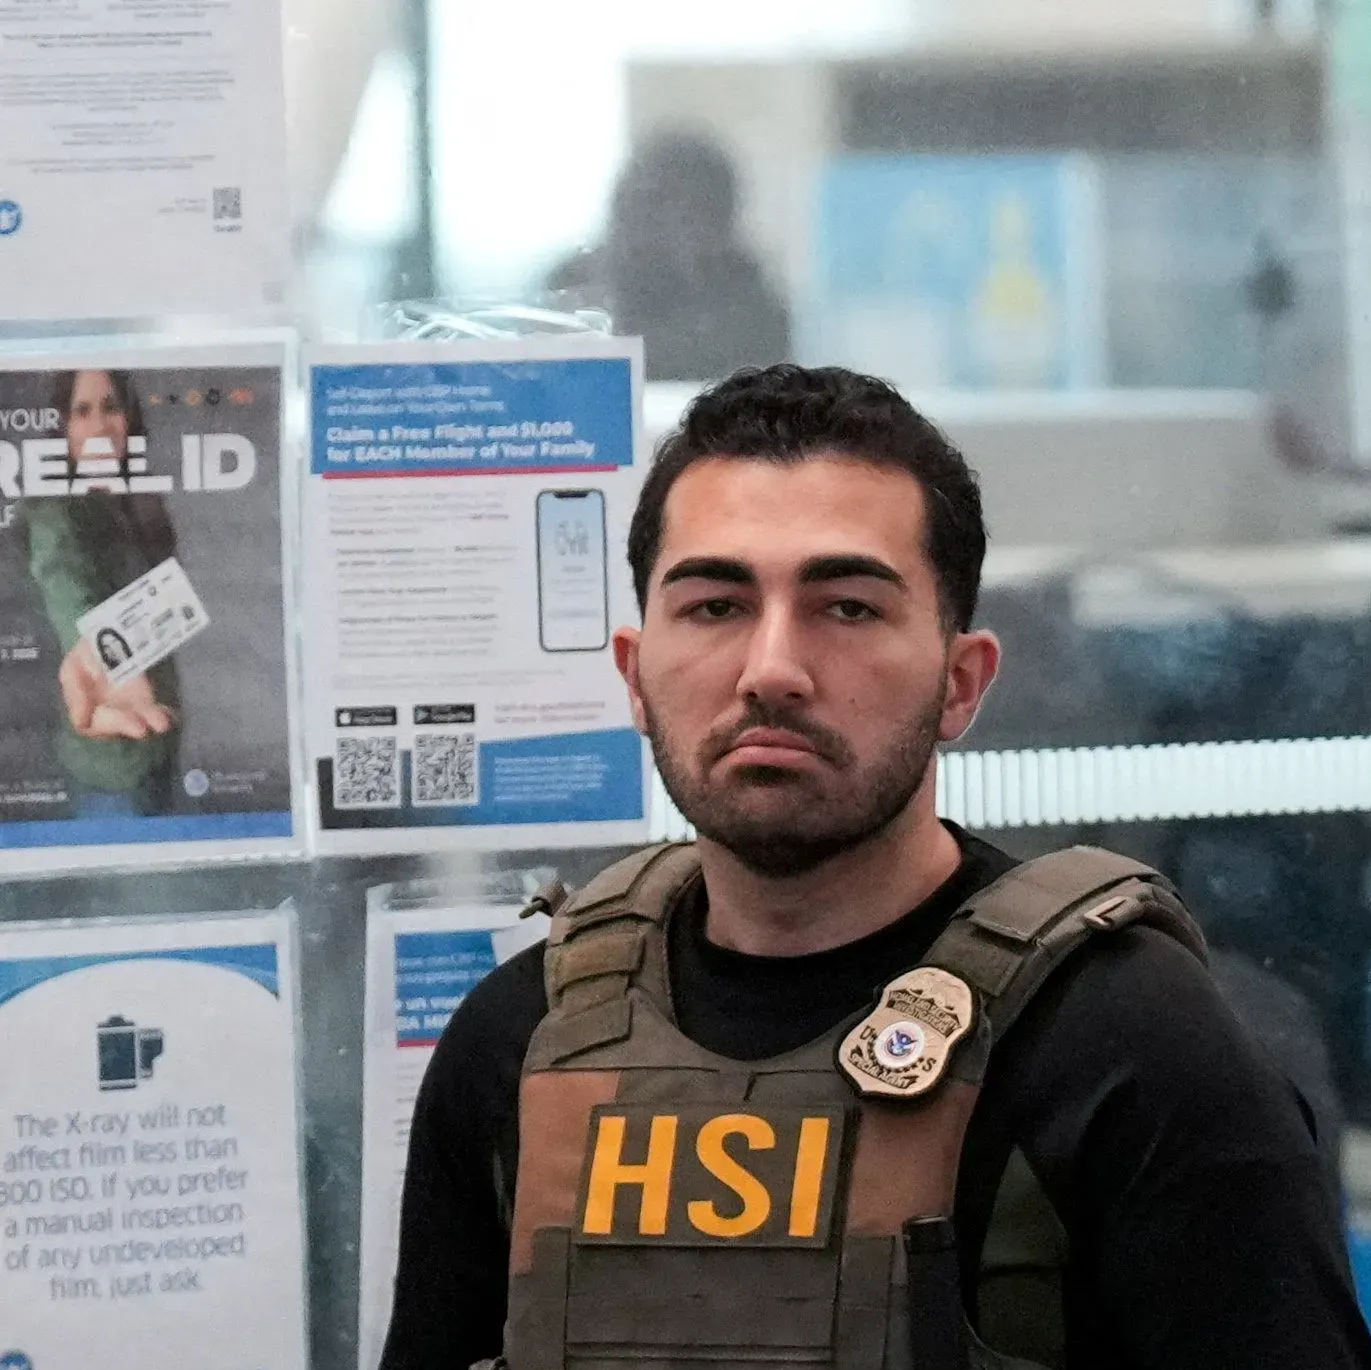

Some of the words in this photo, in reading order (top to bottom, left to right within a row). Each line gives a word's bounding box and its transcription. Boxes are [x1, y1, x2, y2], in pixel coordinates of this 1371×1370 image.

[0, 407, 60, 432] YOUR
[181, 433, 256, 492] ID
[14, 1113, 58, 1138] The
[64, 1110, 130, 1136] X-ray
[137, 1104, 179, 1131] will
[186, 1103, 226, 1127] not
[4, 1144, 71, 1173] affect
[78, 1142, 126, 1168] film
[133, 1138, 177, 1163] less
[184, 1136, 238, 1161] than
[125, 1174, 170, 1201] you
[177, 1165, 248, 1197] prefer
[582, 1113, 830, 1238] HSI
[4, 1218, 17, 1239] a
[26, 1207, 113, 1236] manual
[121, 1202, 245, 1230] inspection
[5, 1243, 29, 1271] of
[38, 1246, 81, 1271] any
[89, 1231, 246, 1264] undeveloped
